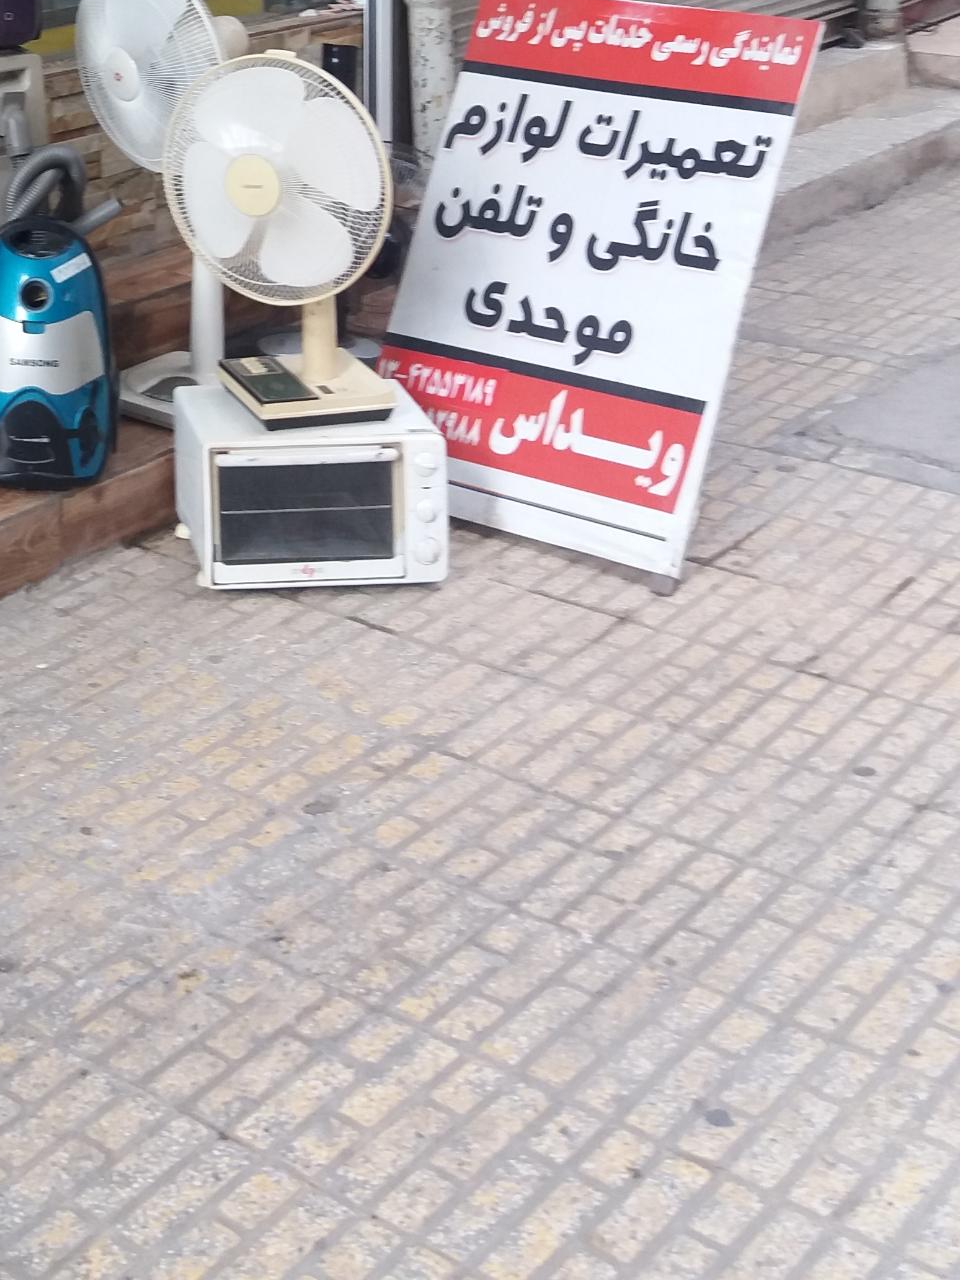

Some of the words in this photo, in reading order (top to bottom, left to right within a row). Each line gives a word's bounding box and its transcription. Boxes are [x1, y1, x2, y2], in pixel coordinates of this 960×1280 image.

[476, 3, 536, 42] فروش
[528, 7, 558, 45] از
[550, 20, 588, 52] پس
[587, 14, 654, 48] خدمات
[650, 35, 710, 65] رسمی
[709, 30, 804, 71] نمایندگی
[445, 93, 573, 163] لوازم
[579, 108, 773, 181] تعمیرات
[434, 184, 546, 240] تلفن
[547, 209, 575, 263] و
[587, 200, 721, 272] خانگی
[465, 280, 634, 365] موحدی
